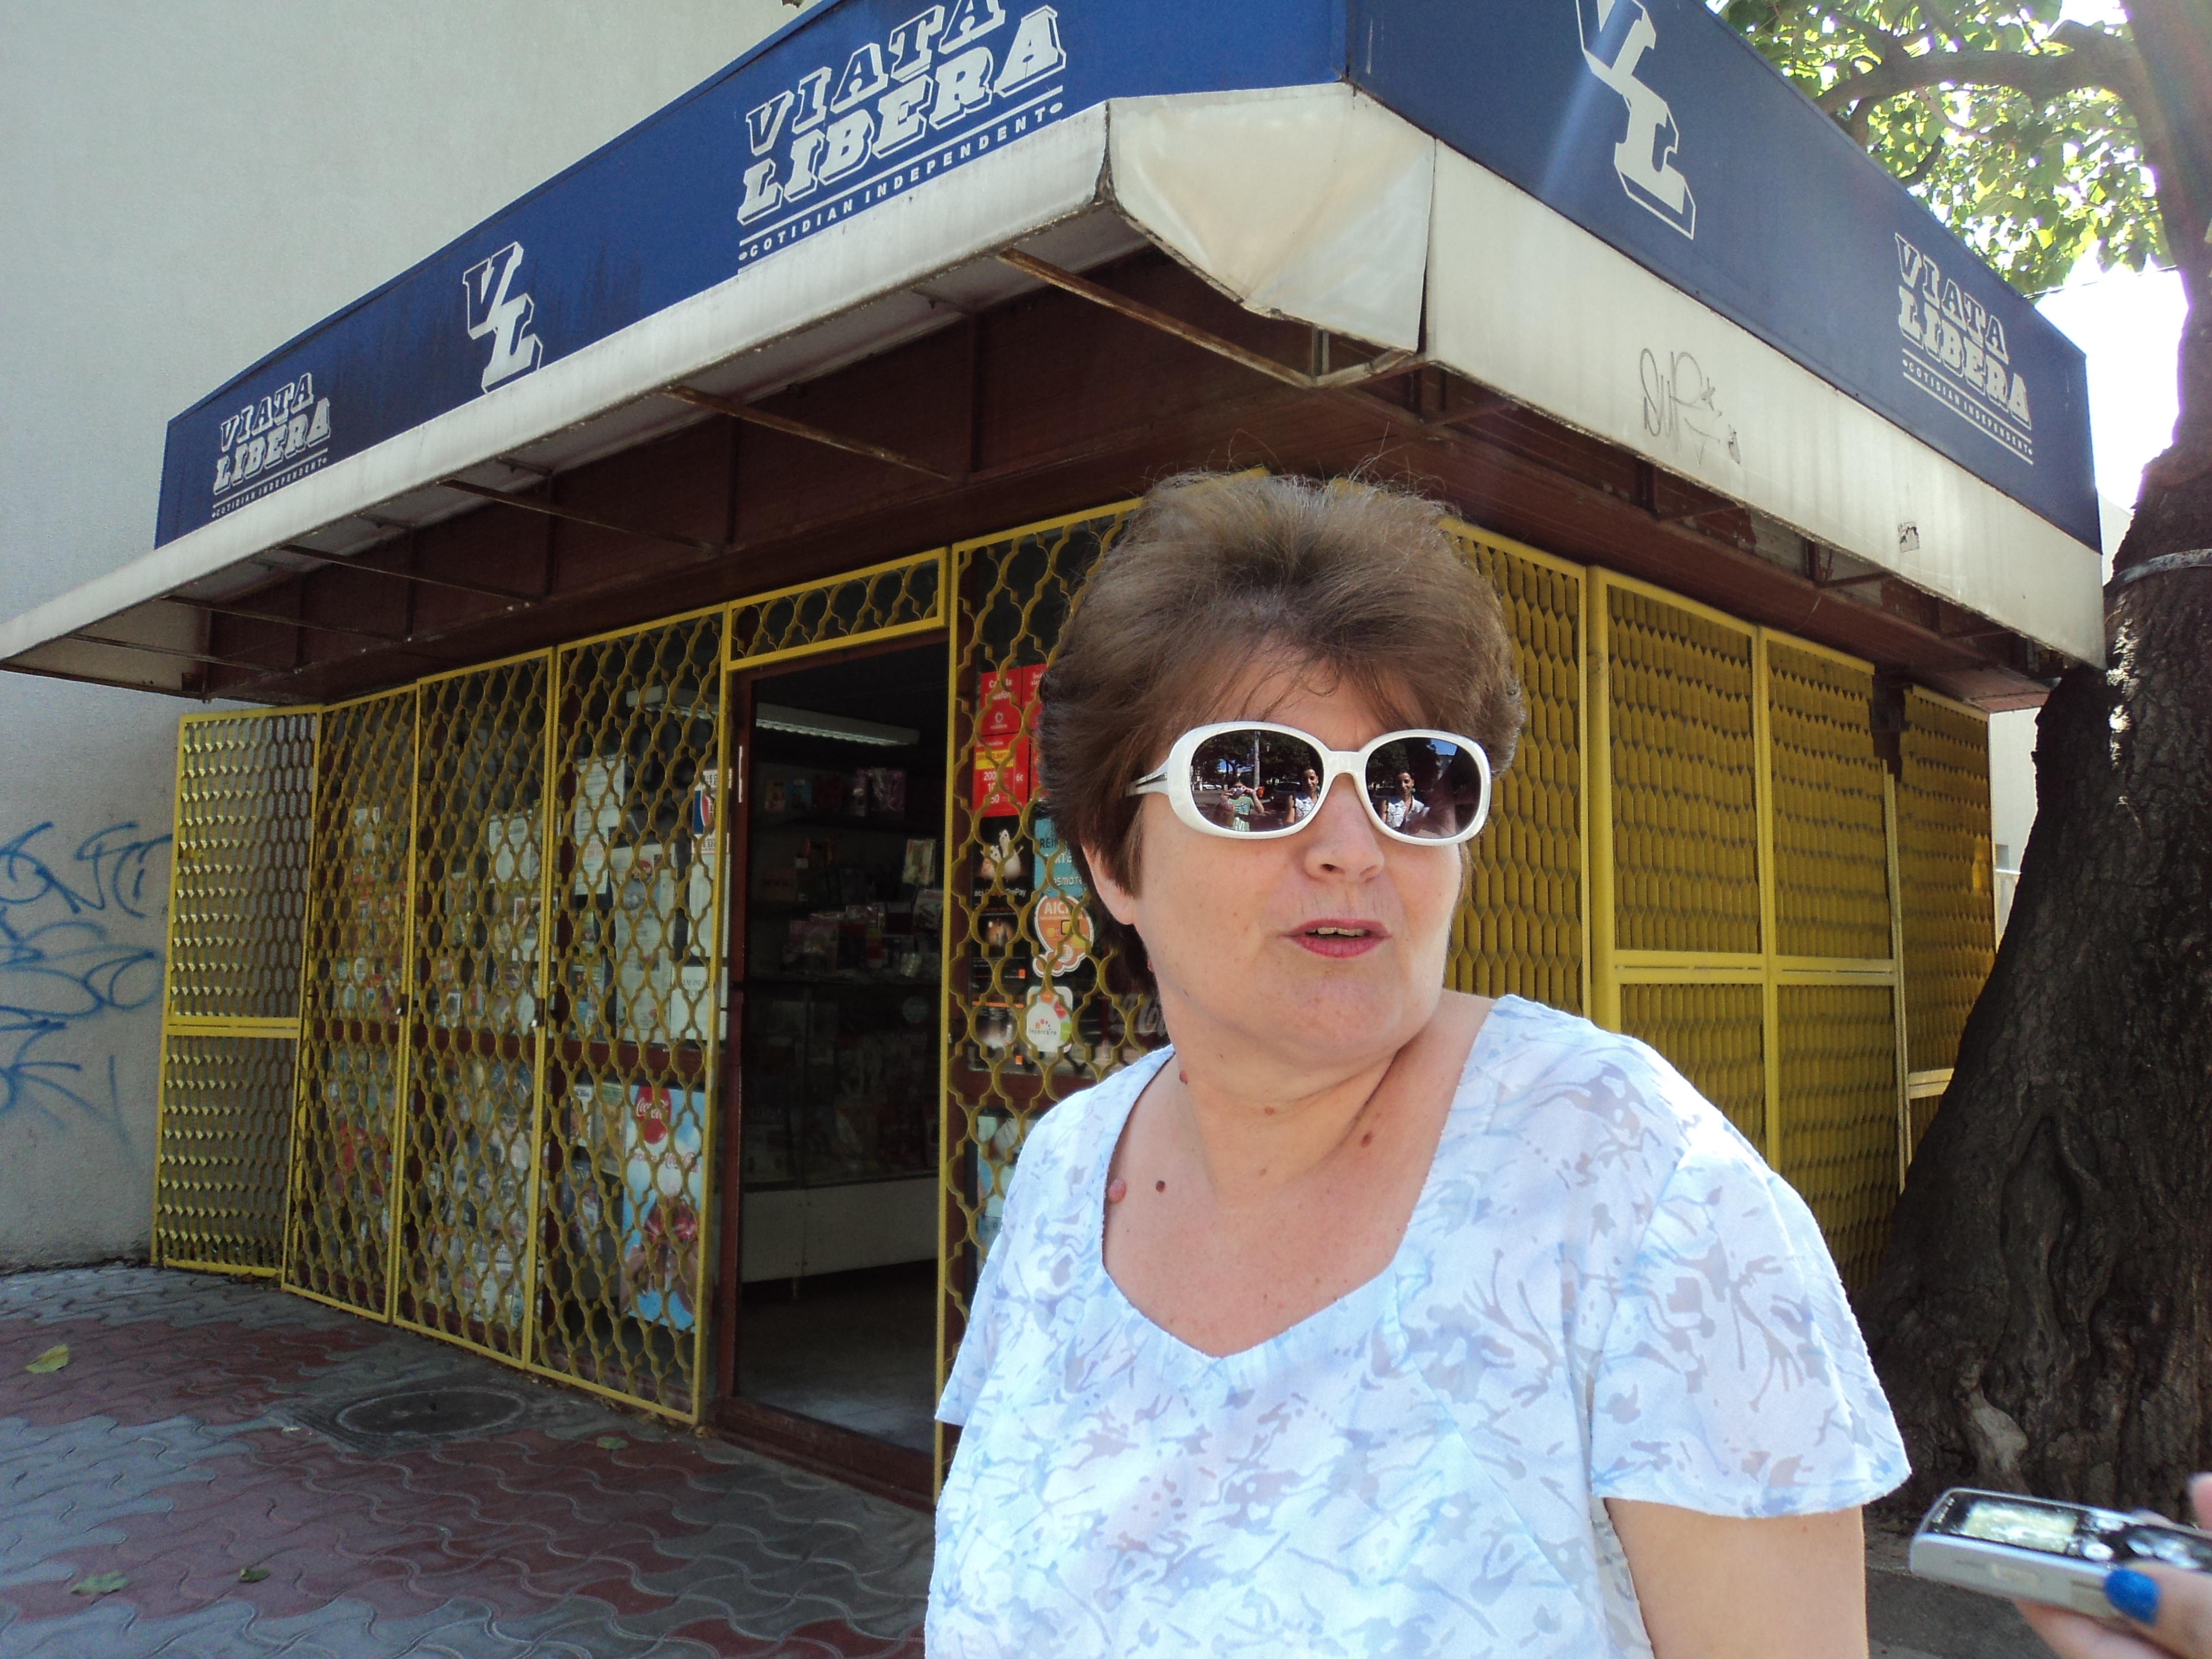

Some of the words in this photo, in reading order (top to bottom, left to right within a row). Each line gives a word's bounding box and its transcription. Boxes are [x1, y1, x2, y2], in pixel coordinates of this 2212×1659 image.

[737, 4, 1067, 226] LIBERA
[750, 199, 853, 257] COTIDIAN
[865, 106, 1046, 203] INDEPENDENT
[1894, 232, 2009, 365] VIATA
[221, 372, 314, 452] VIATA
[1898, 285, 2032, 431] LIBERA
[1909, 362, 1960, 405] COTIDIAN
[1964, 401, 2028, 453] INDEPENDENT
[213, 398, 331, 495] LIBERA
[216, 492, 256, 517] COTIDIAN
[258, 457, 324, 497] INDEPENDENT
